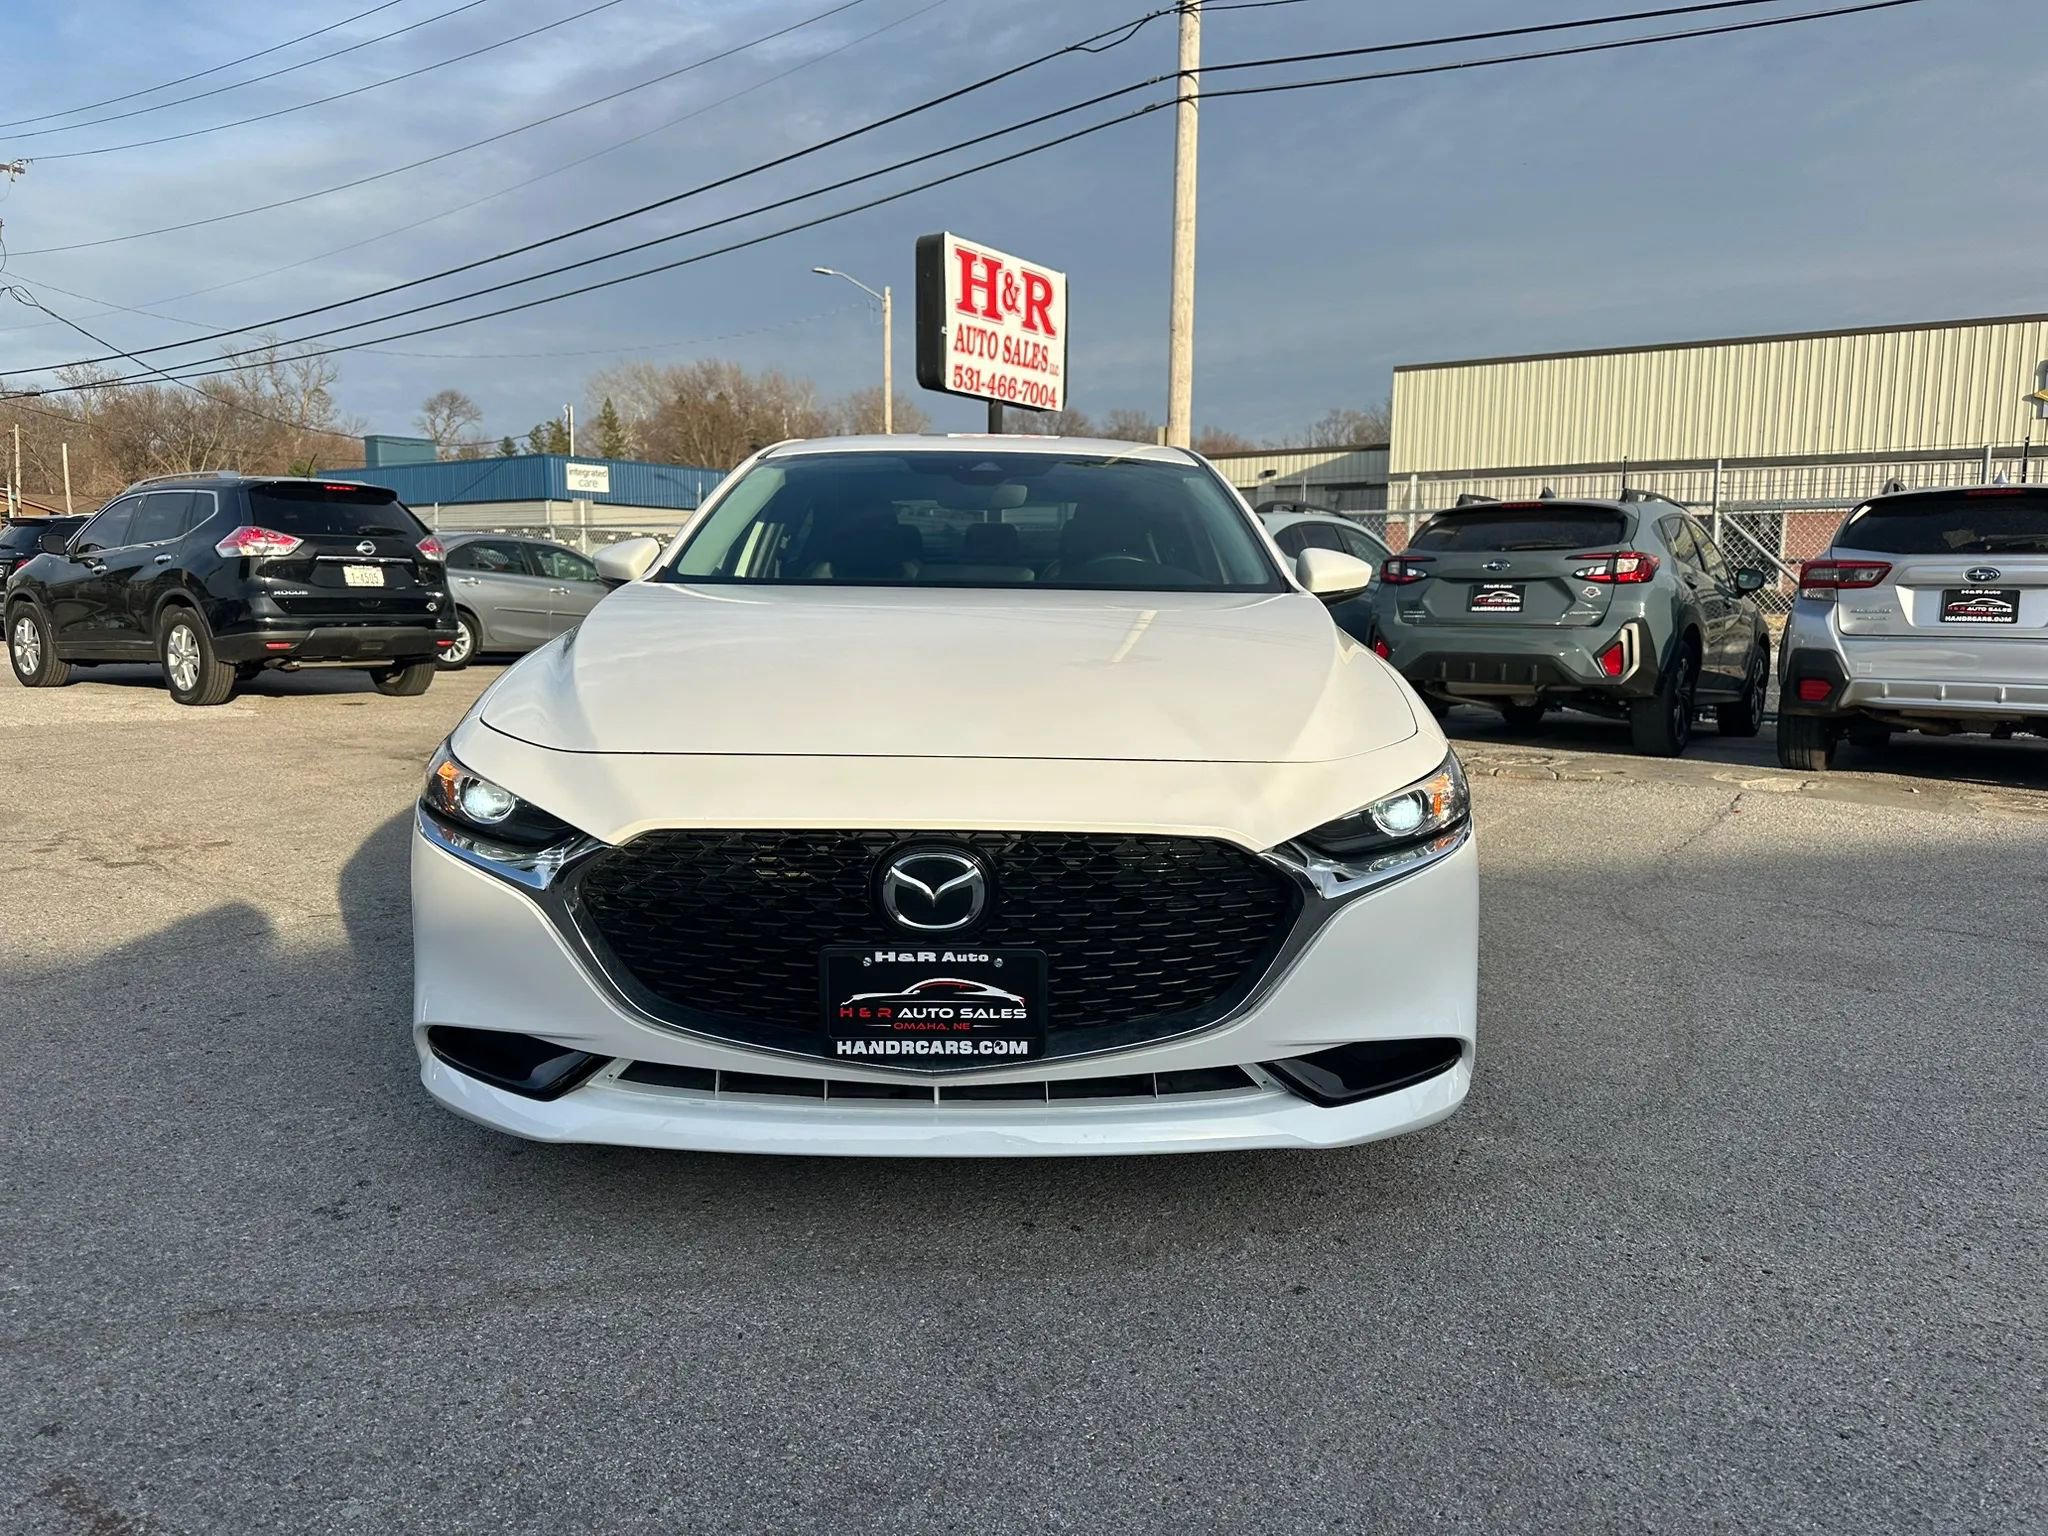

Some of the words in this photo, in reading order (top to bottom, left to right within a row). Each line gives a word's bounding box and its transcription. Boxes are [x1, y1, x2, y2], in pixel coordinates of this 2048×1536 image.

[955, 247, 1057, 337] H&R
[954, 323, 998, 360] AUTO
[1003, 335, 1049, 373] SALES
[953, 364, 1057, 408] 531-466-7004
[568, 466, 608, 478] integrated
[578, 479, 599, 488] care
[874, 951, 937, 963] H&R
[941, 951, 989, 963] Auto
[840, 1007, 853, 1018] H
[877, 1007, 892, 1018] R
[897, 1007, 954, 1019] AUTO
[959, 1007, 1027, 1019] SALES
[893, 1022, 950, 1031] OMAHA,
[953, 1022, 971, 1030] NE
[836, 1040, 1028, 1055] HANDRCARS.COM
